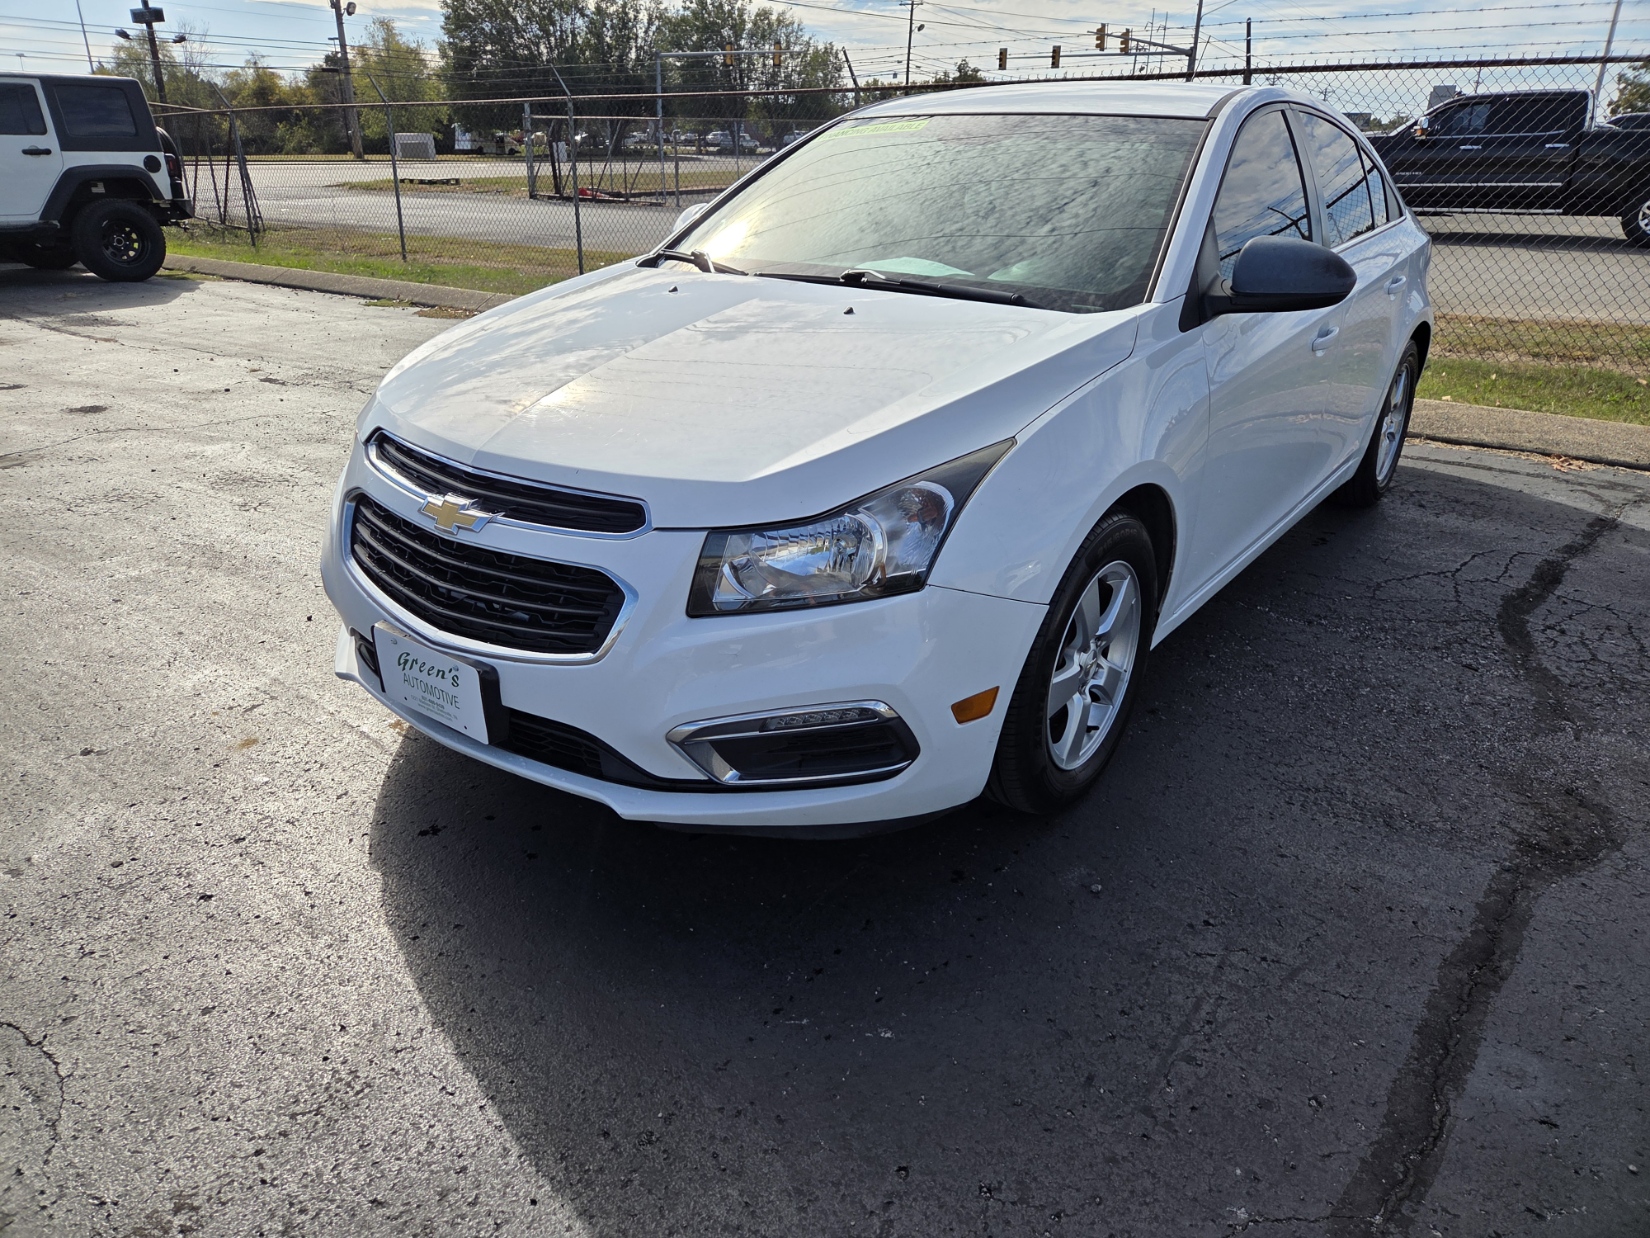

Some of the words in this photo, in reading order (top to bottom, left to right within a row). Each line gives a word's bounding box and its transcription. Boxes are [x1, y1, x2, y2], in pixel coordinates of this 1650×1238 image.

[868, 122, 924, 133] AVAILABLE
[397, 651, 460, 688] Green's
[403, 672, 461, 710] AUTOMOTIVE
